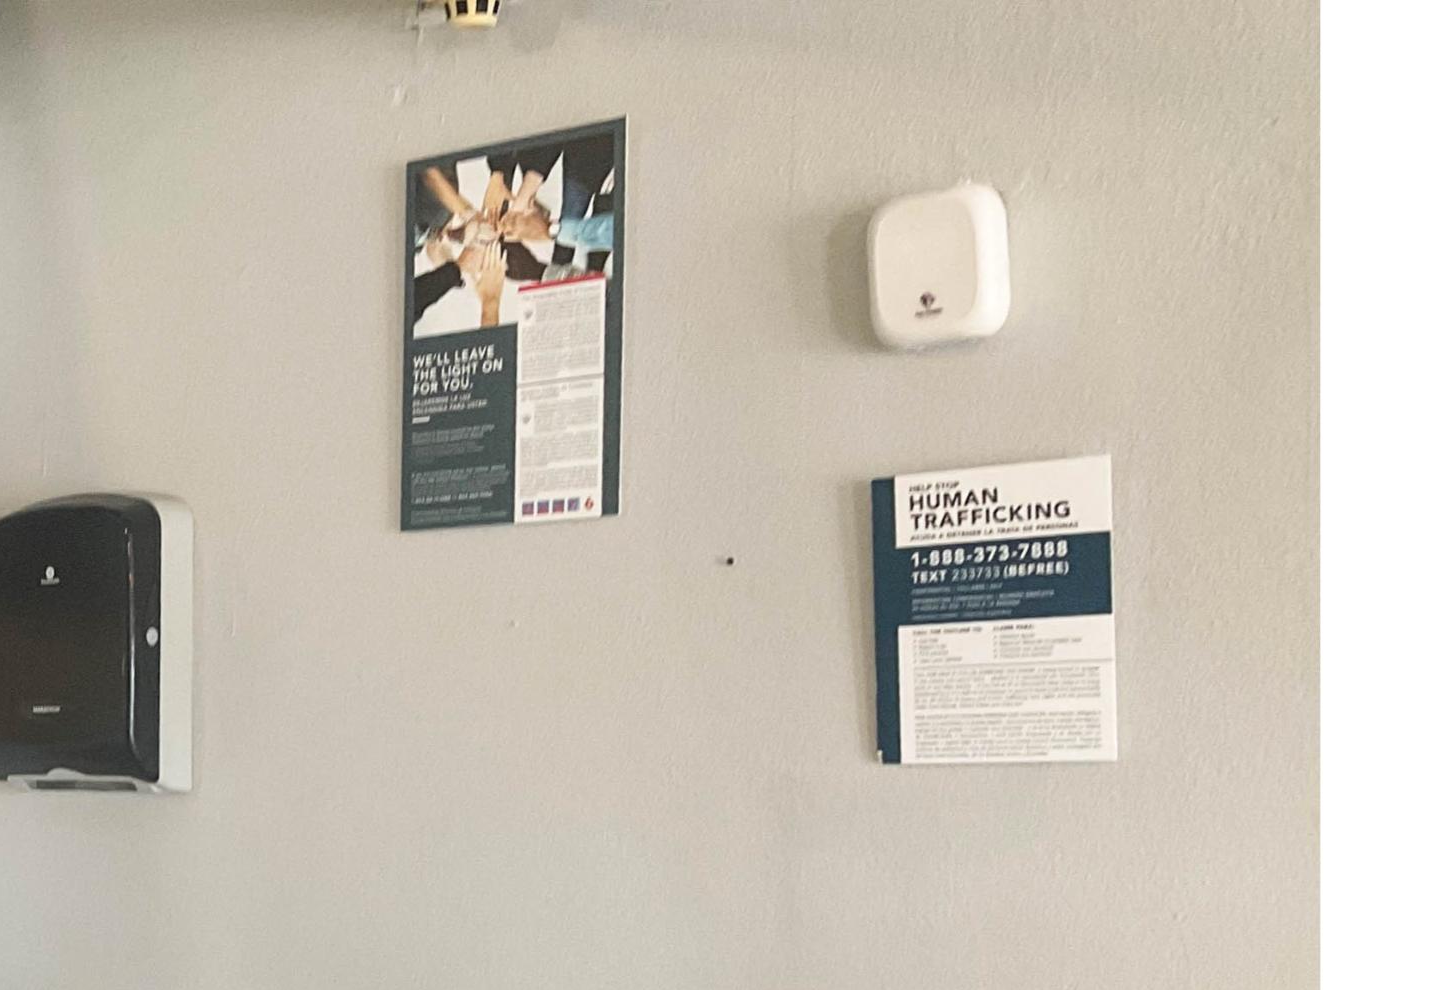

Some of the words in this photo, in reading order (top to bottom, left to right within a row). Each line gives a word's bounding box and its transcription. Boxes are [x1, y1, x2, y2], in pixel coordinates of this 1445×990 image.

[413, 351, 450, 369] WE'LL
[455, 343, 494, 363] LEAVE
[413, 366, 437, 382] THE
[441, 360, 478, 379] LIGHT
[482, 357, 503, 374] ON
[412, 381, 439, 396] FOR
[909, 486, 999, 512] HUMAN
[910, 500, 1071, 531] TRAFFICKING
[911, 539, 1068, 568] 1-888-373-7888
[911, 569, 948, 585] TEXT
[951, 566, 1001, 583] 233733
[1003, 560, 1070, 579] (BEFREE)
